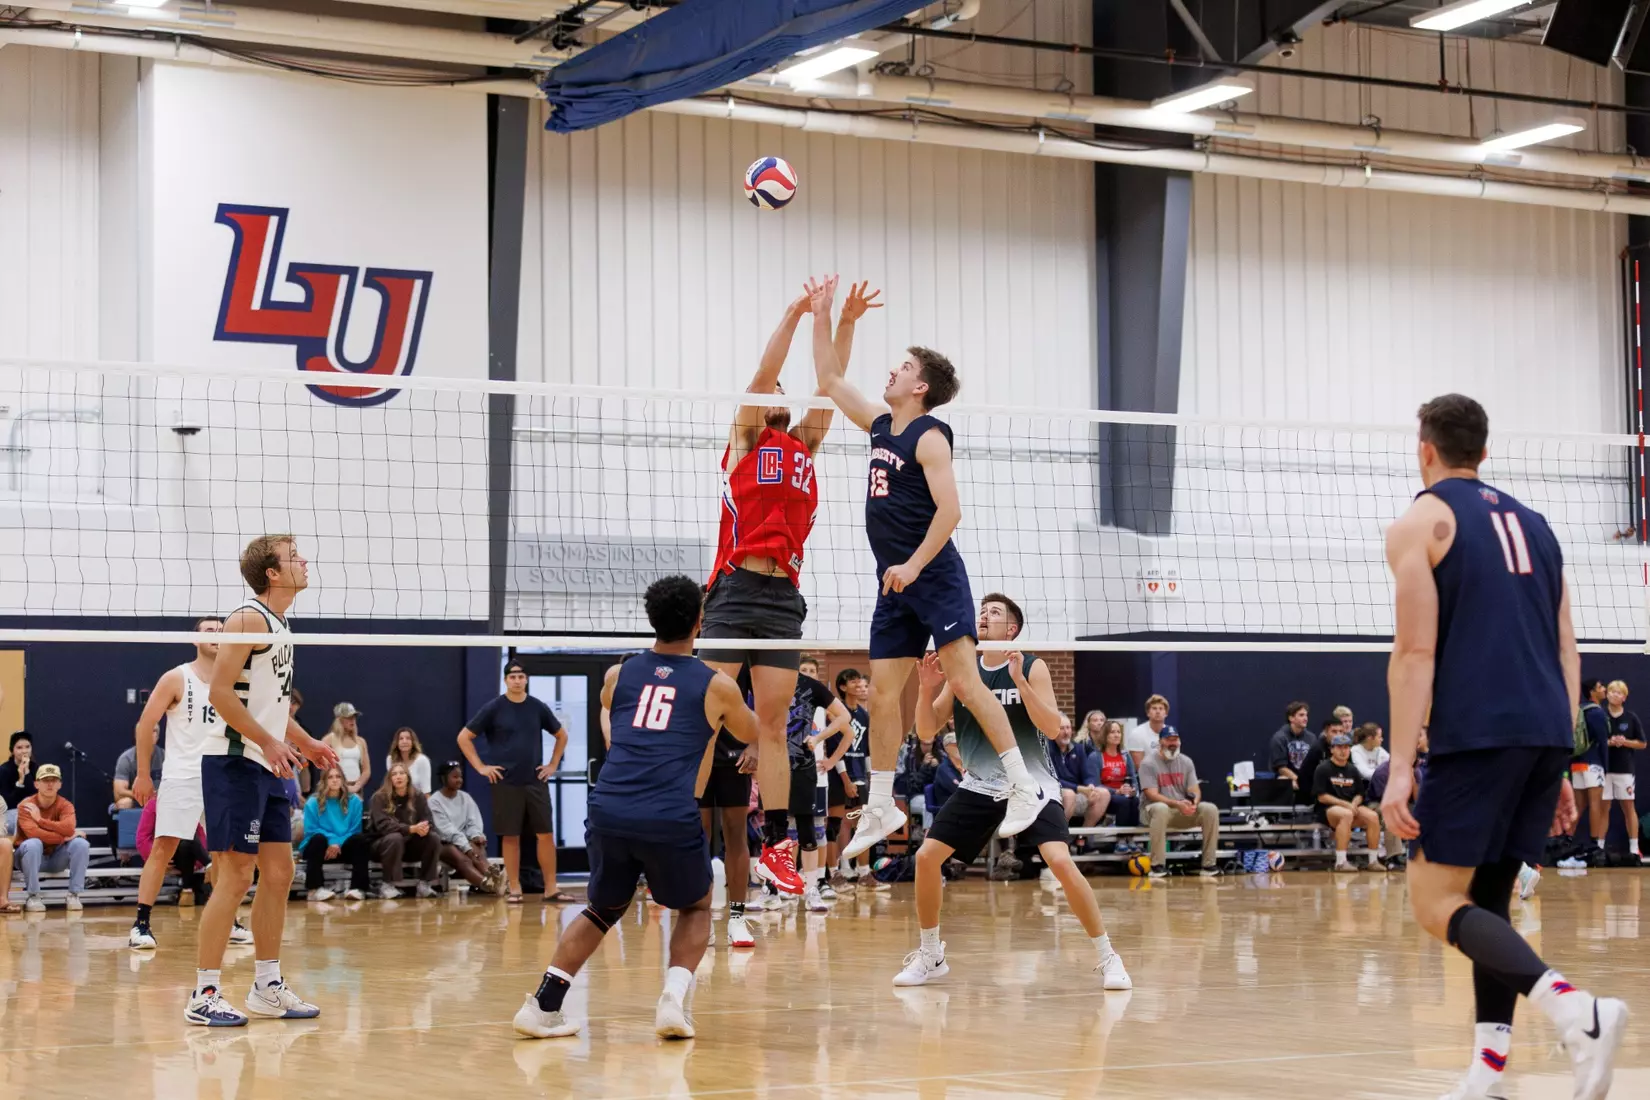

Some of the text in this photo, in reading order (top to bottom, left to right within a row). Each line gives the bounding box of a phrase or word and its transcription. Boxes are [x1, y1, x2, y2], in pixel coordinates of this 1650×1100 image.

[213, 203, 434, 408] LU
[791, 452, 813, 495] 32
[870, 467, 889, 498] 15
[528, 544, 686, 564] THOMAS INDOOR
[1488, 510, 1533, 576] 11
[529, 568, 605, 585] SOCCER
[202, 705, 217, 724] 19
[632, 684, 677, 731] 16
